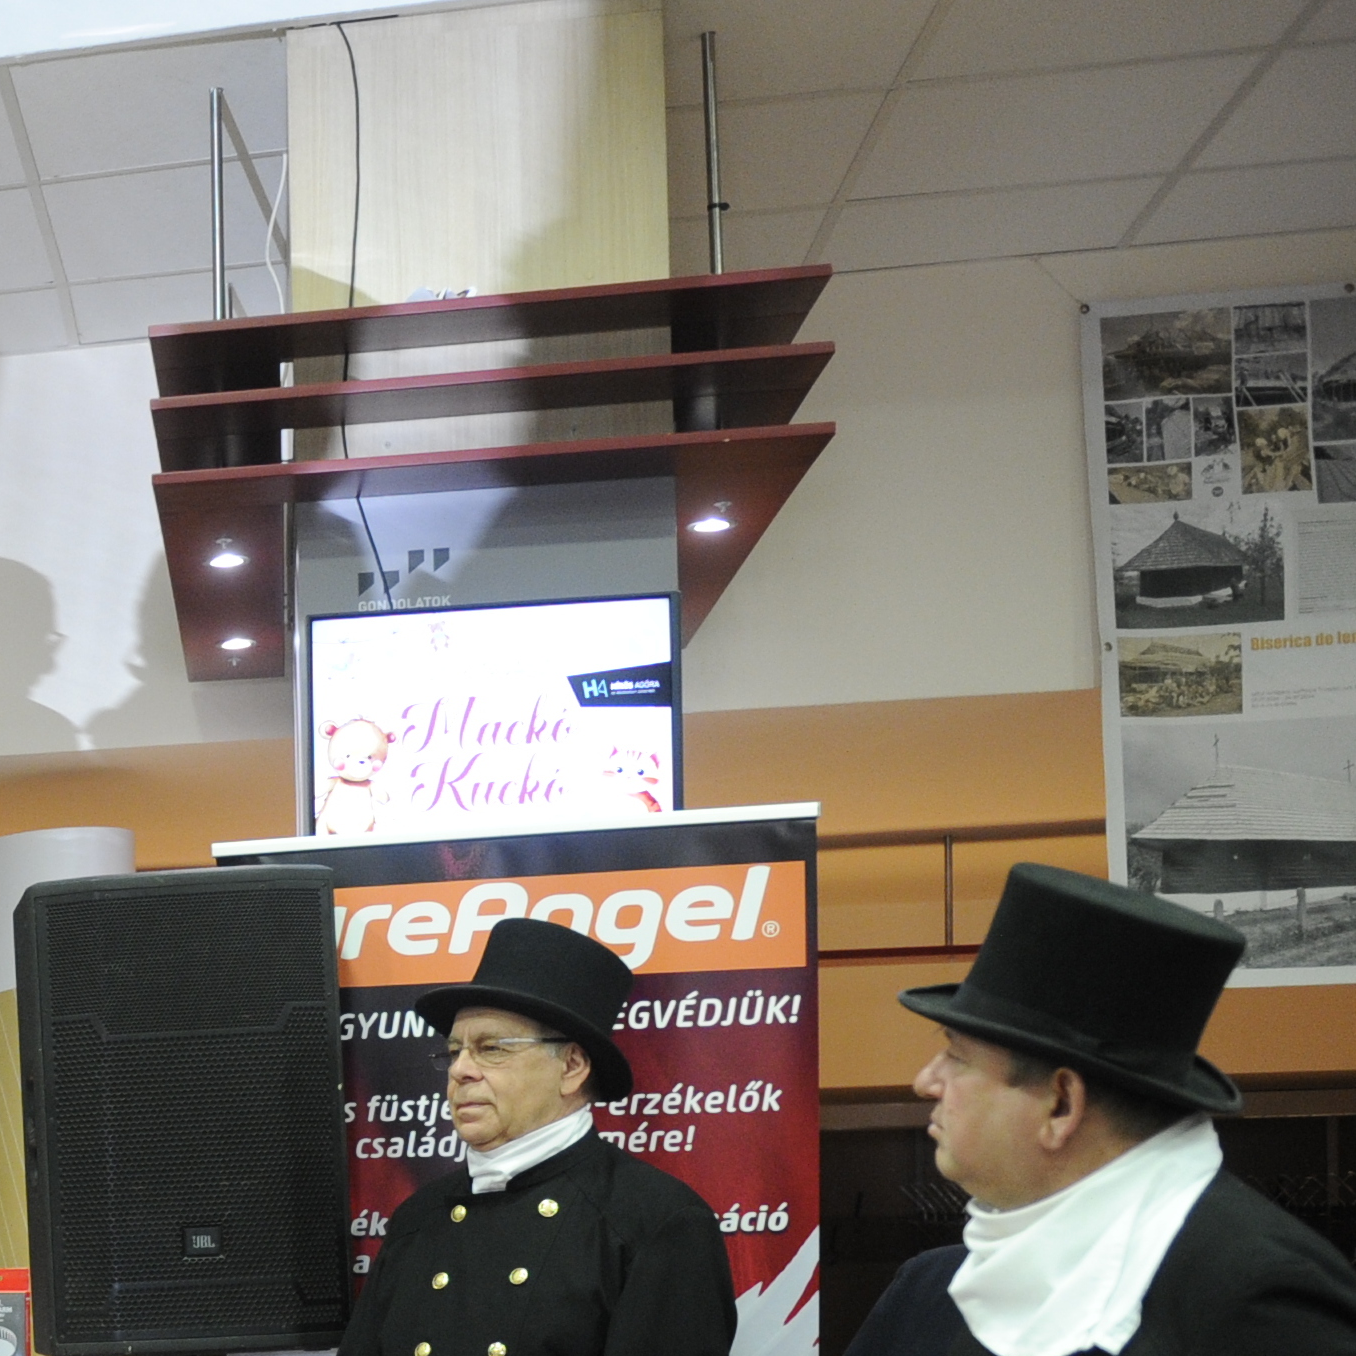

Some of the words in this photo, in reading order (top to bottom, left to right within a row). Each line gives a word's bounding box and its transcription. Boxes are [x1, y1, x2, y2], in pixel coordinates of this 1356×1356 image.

[340, 1010, 435, 1041] GYUN
[714, 1202, 789, 1232] áció
[192, 1234, 216, 1249] JBL
